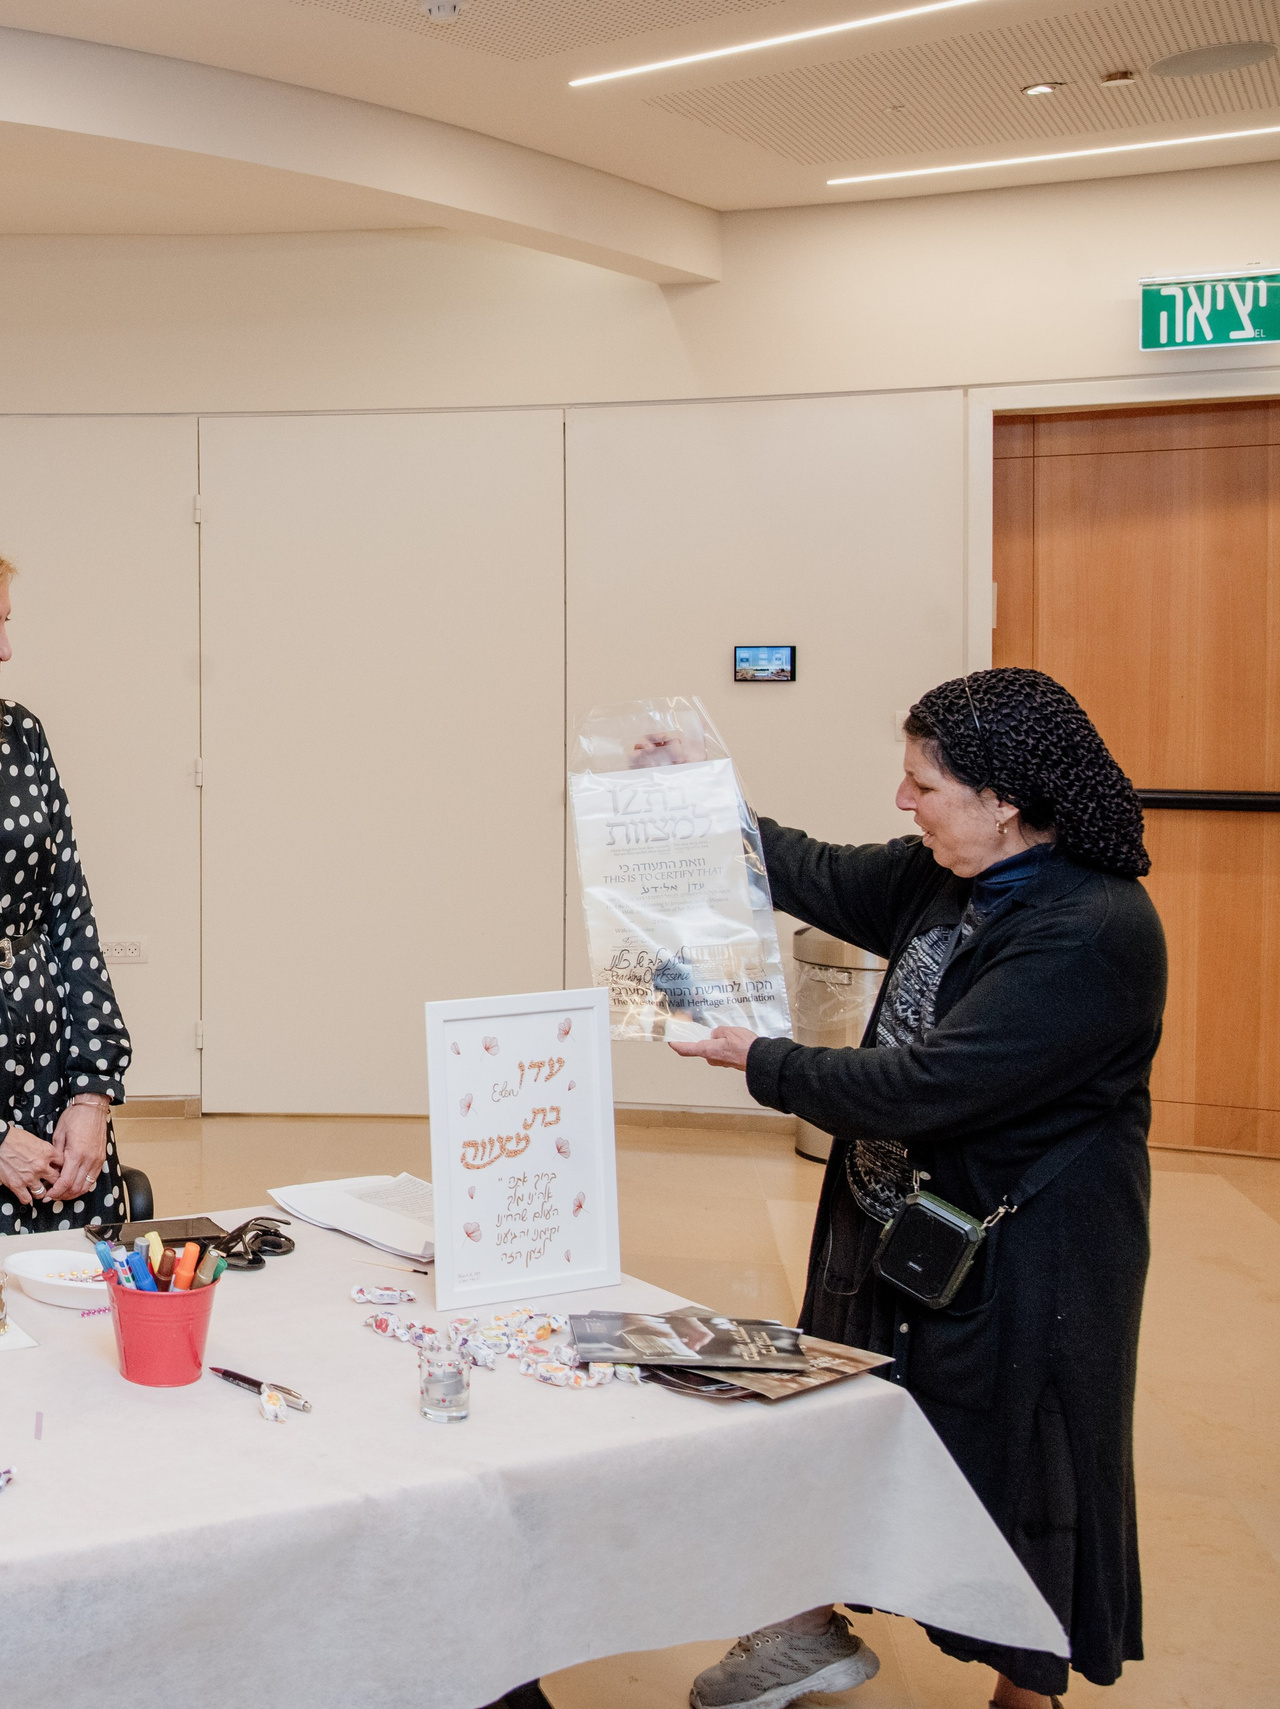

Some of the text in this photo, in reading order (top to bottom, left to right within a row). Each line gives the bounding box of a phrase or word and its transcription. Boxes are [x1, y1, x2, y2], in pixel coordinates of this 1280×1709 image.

[1160, 280, 1267, 344] יציאה
[619, 858, 707, 873] וזאת התעודה כי
[603, 866, 724, 884] THIS IS TO CERTIFY THAT
[687, 881, 705, 893] עדן
[659, 968, 690, 984] Essence
[695, 981, 741, 996] למורשת
[745, 980, 773, 993] הקרן
[667, 998, 686, 1008] Wall
[687, 998, 725, 1008] Heritage
[726, 993, 776, 1005] Foundation
[518, 1056, 565, 1090] עדן
[491, 1080, 519, 1103] Eden
[522, 1105, 561, 1131] בת
[460, 1132, 531, 1170] מצווה
[534, 1172, 558, 1191] ברוך
[507, 1185, 524, 1212] מלך
[501, 1251, 523, 1264] הזה
